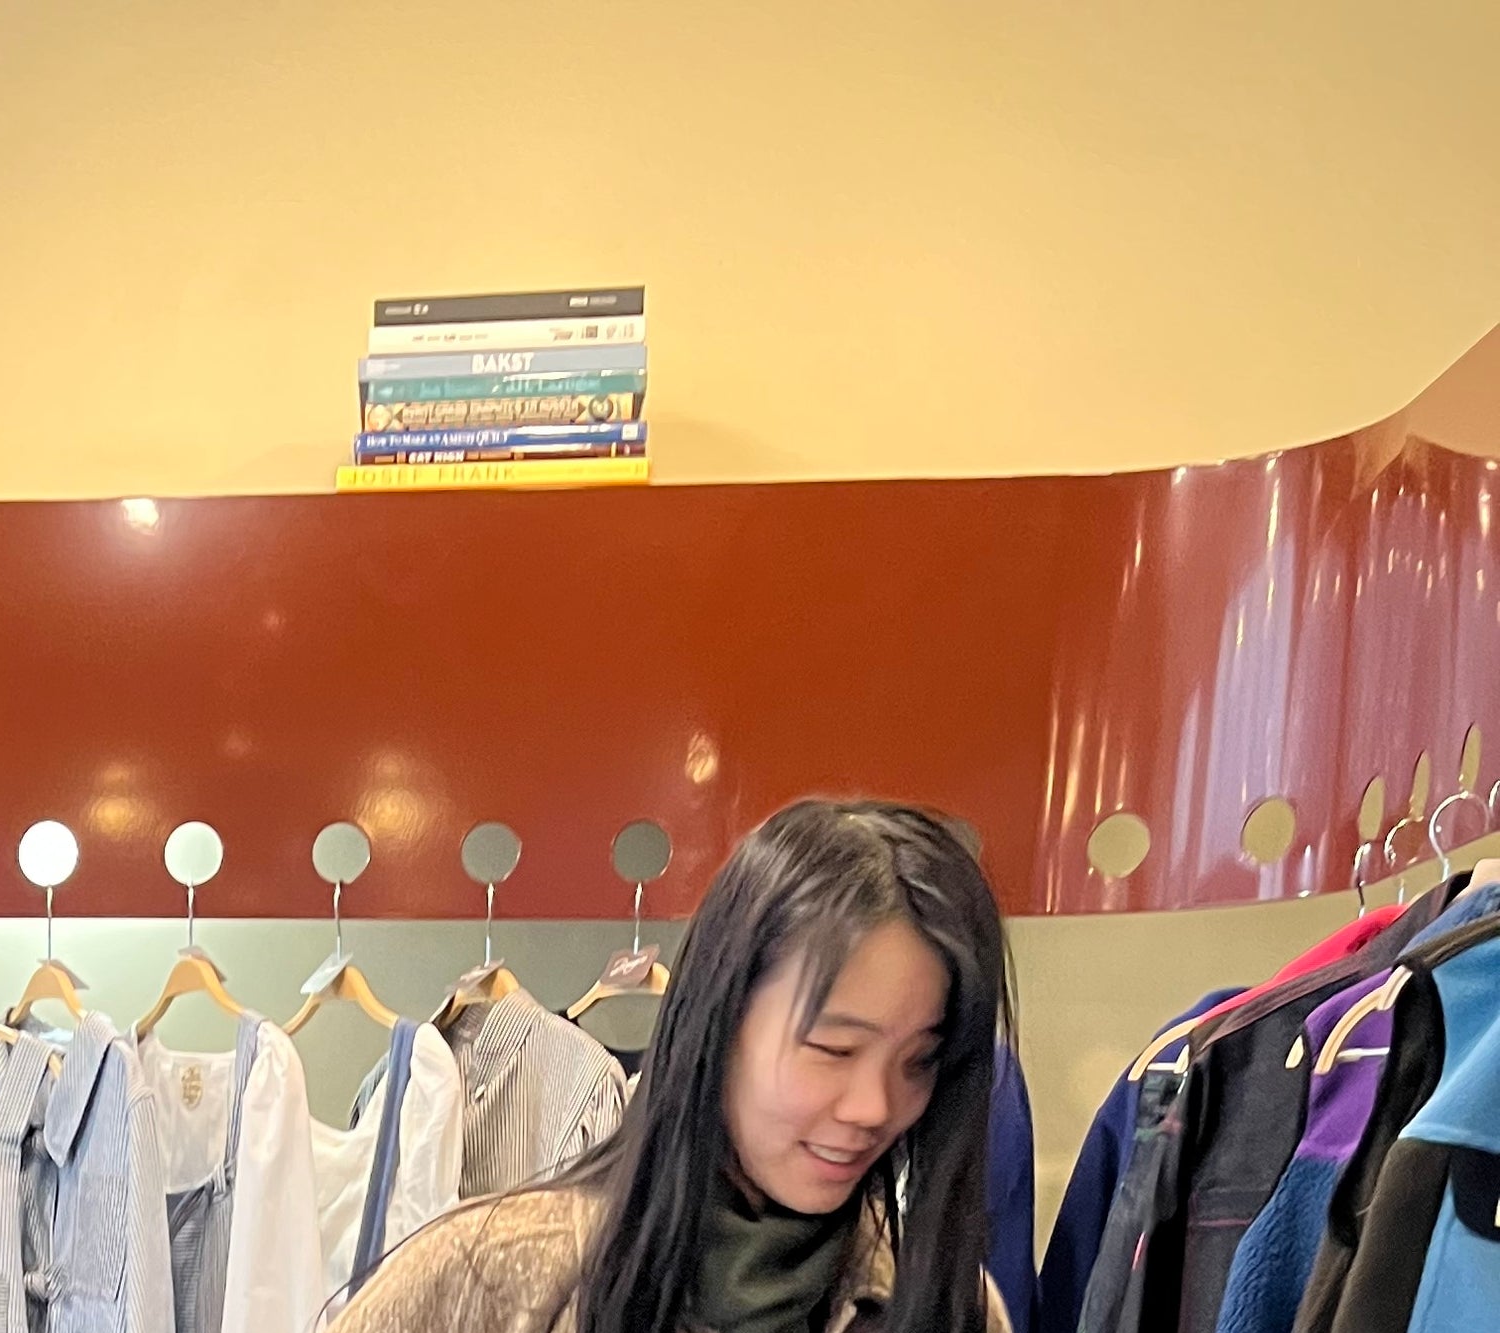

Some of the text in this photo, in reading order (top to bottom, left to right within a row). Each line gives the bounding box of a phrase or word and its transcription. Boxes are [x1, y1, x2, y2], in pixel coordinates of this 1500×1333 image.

[472, 352, 534, 373] BAKST
[347, 467, 425, 486] JOSEF
[439, 464, 516, 483] FRANK
